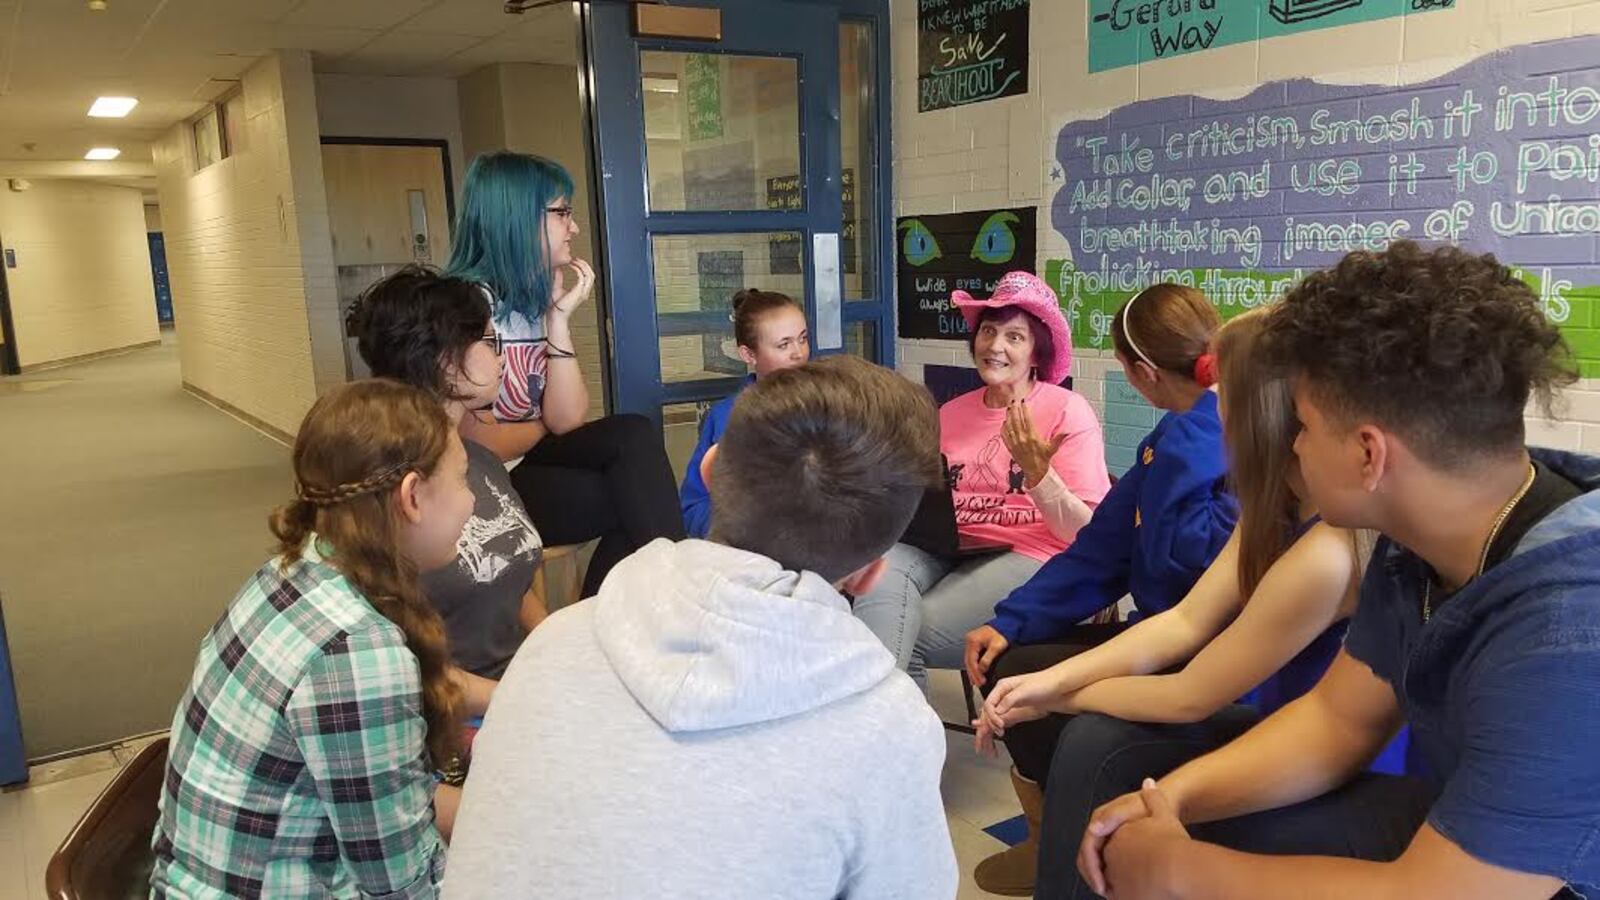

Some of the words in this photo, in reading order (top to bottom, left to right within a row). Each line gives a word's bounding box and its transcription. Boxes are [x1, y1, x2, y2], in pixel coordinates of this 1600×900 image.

[974, 16, 988, 31] BE
[1093, 0, 1216, 31] -Gerar
[1150, 16, 1224, 57] Way
[1444, 90, 1482, 139] it
[1495, 76, 1600, 131] into
[1069, 179, 1113, 214] Add
[1204, 159, 1270, 204] and
[1290, 159, 1362, 196] use
[1389, 152, 1426, 196] it
[1448, 146, 1498, 192] to
[1080, 216, 1262, 268] breathtaking
[1424, 200, 1474, 247] of
[915, 278, 947, 292] Wide
[939, 315, 972, 333] Blu
[1059, 297, 1083, 336] f
